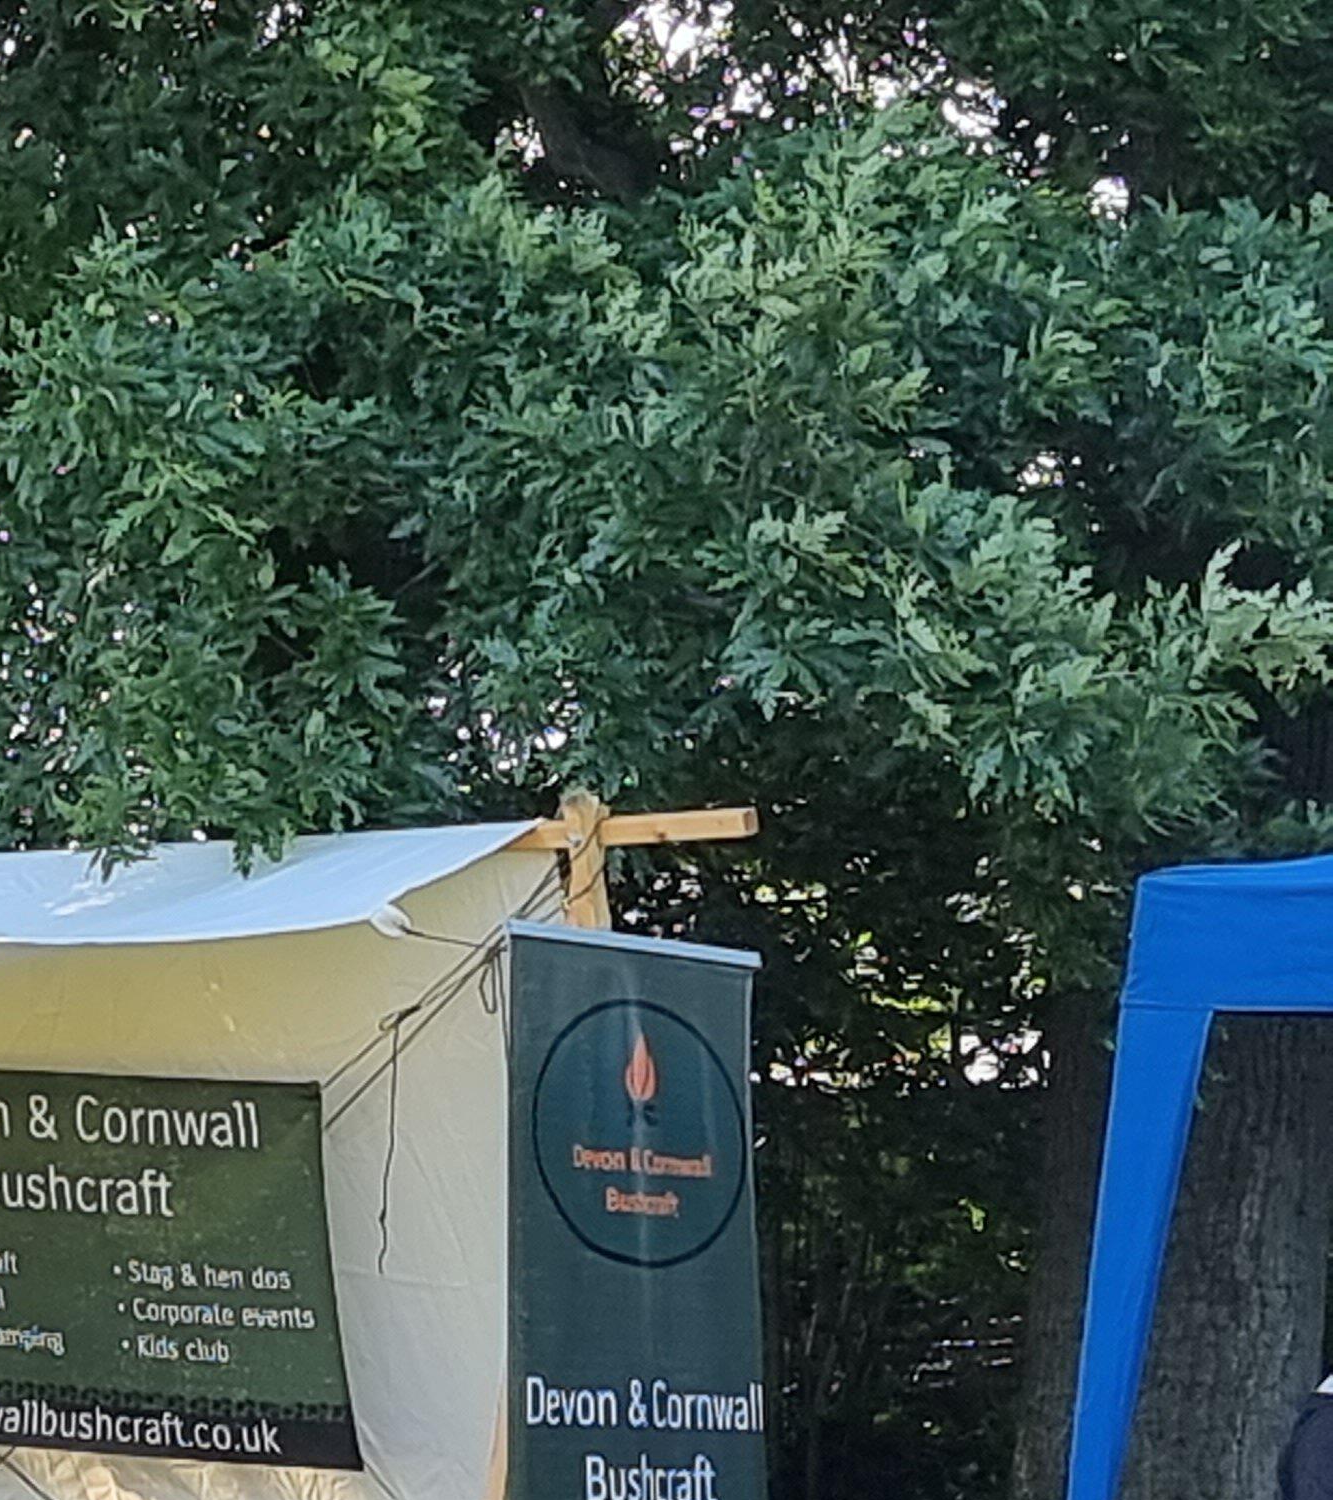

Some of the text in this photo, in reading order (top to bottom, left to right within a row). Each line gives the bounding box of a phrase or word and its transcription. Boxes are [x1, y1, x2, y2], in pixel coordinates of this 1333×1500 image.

[28, 1094, 59, 1141] &
[75, 1094, 260, 1150] Cornwall
[572, 1143, 627, 1172] Devon
[605, 1186, 680, 1219] Bushcraft
[127, 1259, 292, 1292] Stag & hen dos
[132, 1297, 316, 1330] Corporate events
[136, 1334, 231, 1364] Kids club
[525, 1375, 765, 1433] Devon & Cornwall
